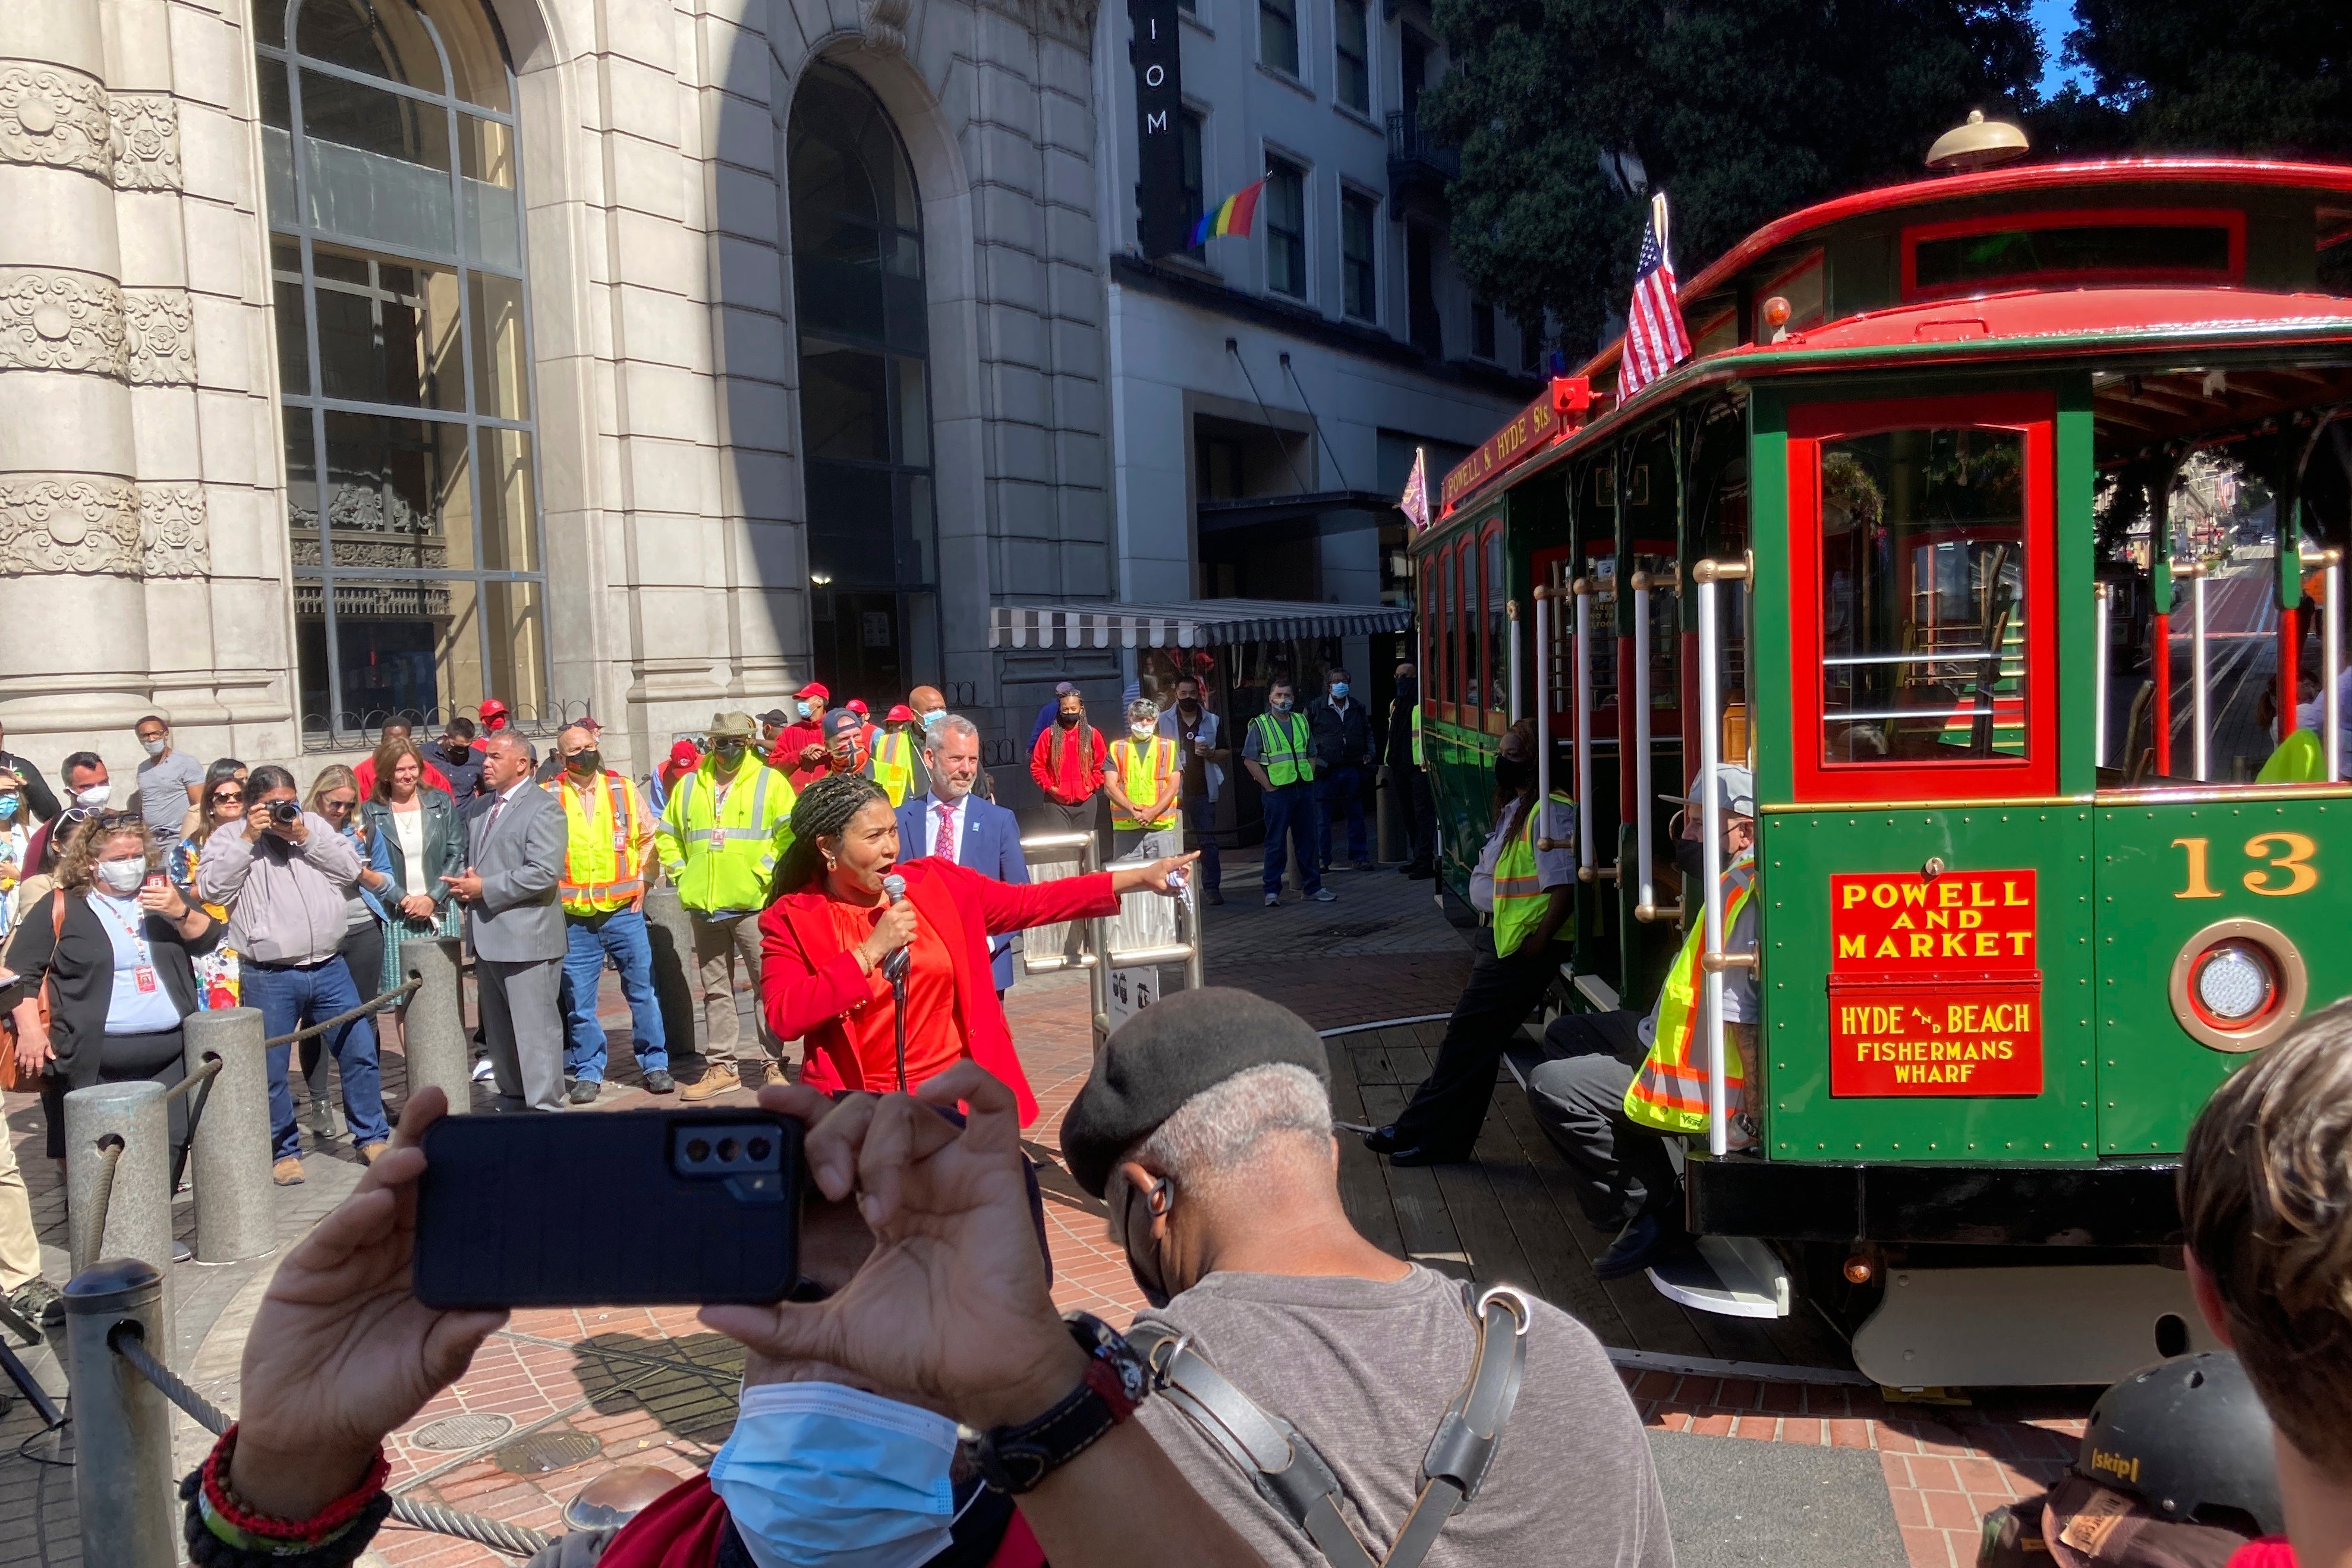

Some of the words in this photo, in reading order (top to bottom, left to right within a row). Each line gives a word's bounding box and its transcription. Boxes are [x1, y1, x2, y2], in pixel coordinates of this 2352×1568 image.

[1449, 458, 1480, 497] POWELL
[1484, 447, 1492, 471] &
[1497, 418, 1526, 461] HYDE
[2170, 832, 2319, 899] 13
[1842, 881, 2029, 909] POWELL
[1890, 909, 1982, 929] AND
[1838, 932, 2032, 958] MARKET
[1841, 1006, 1904, 1035] HYDE
[1911, 1007, 1941, 1034] AND
[1947, 1004, 2030, 1033] BEACH
[1857, 1041, 2013, 1062] FISHERMANS
[1894, 1064, 1975, 1084] WHARF
